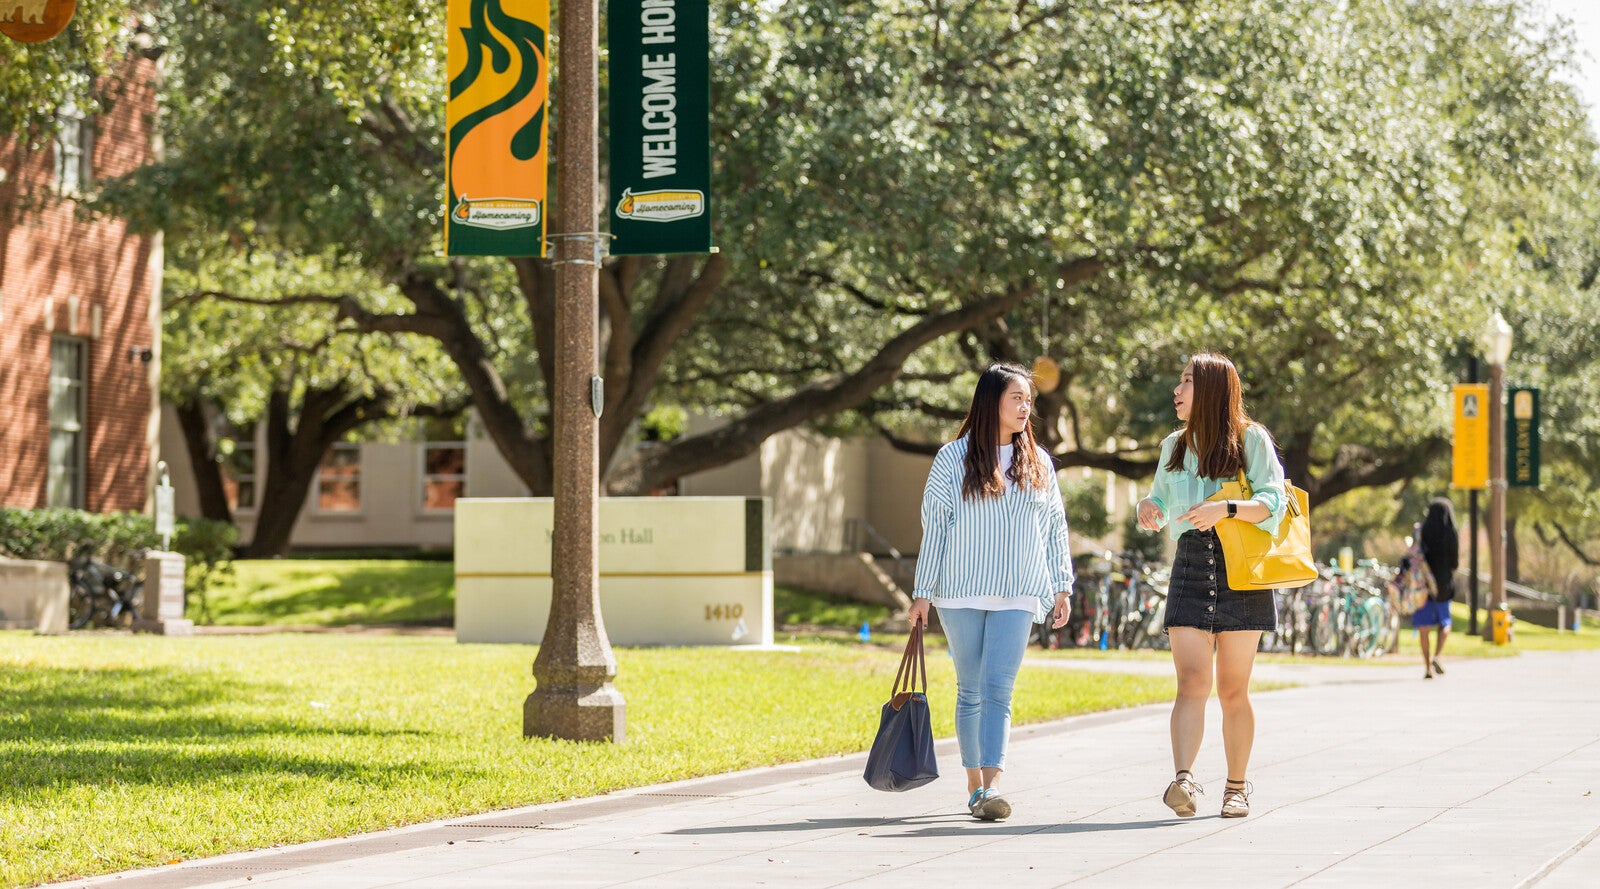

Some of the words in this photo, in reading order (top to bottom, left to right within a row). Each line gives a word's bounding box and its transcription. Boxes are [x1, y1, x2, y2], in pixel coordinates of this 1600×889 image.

[642, 53, 677, 179] WELCOME
[637, 202, 696, 213] Homecoming
[472, 211, 531, 223] Homecoming
[620, 527, 653, 544] Hall
[705, 603, 744, 620] 1410
